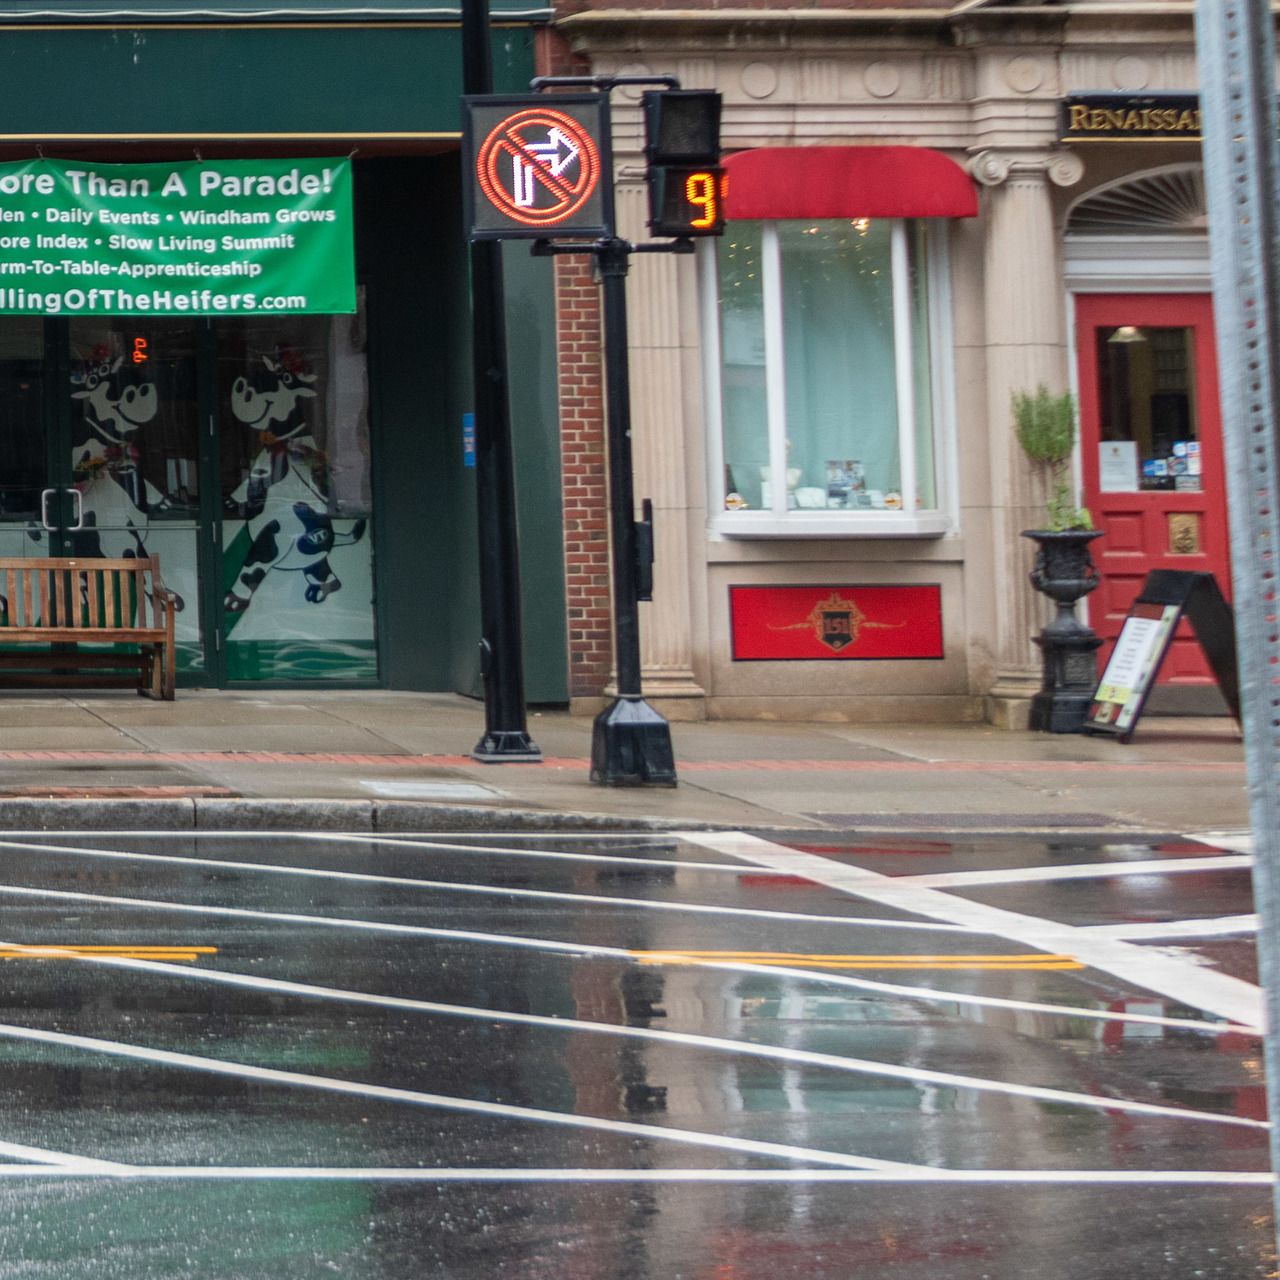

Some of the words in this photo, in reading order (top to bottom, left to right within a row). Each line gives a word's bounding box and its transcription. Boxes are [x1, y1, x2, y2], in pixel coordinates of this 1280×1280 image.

[1069, 105, 1201, 131] RENAISSA
[65, 170, 150, 197] Than
[160, 171, 188, 197] A
[199, 168, 333, 197] Parade!
[685, 172, 717, 229] 9
[45, 207, 94, 225] Daily
[98, 209, 160, 225] Events
[179, 209, 271, 225] Windham
[275, 208, 337, 223] Grows
[36, 233, 89, 249] Index
[108, 234, 154, 250] Slow
[158, 235, 217, 253] Living
[221, 233, 296, 250] Summit
